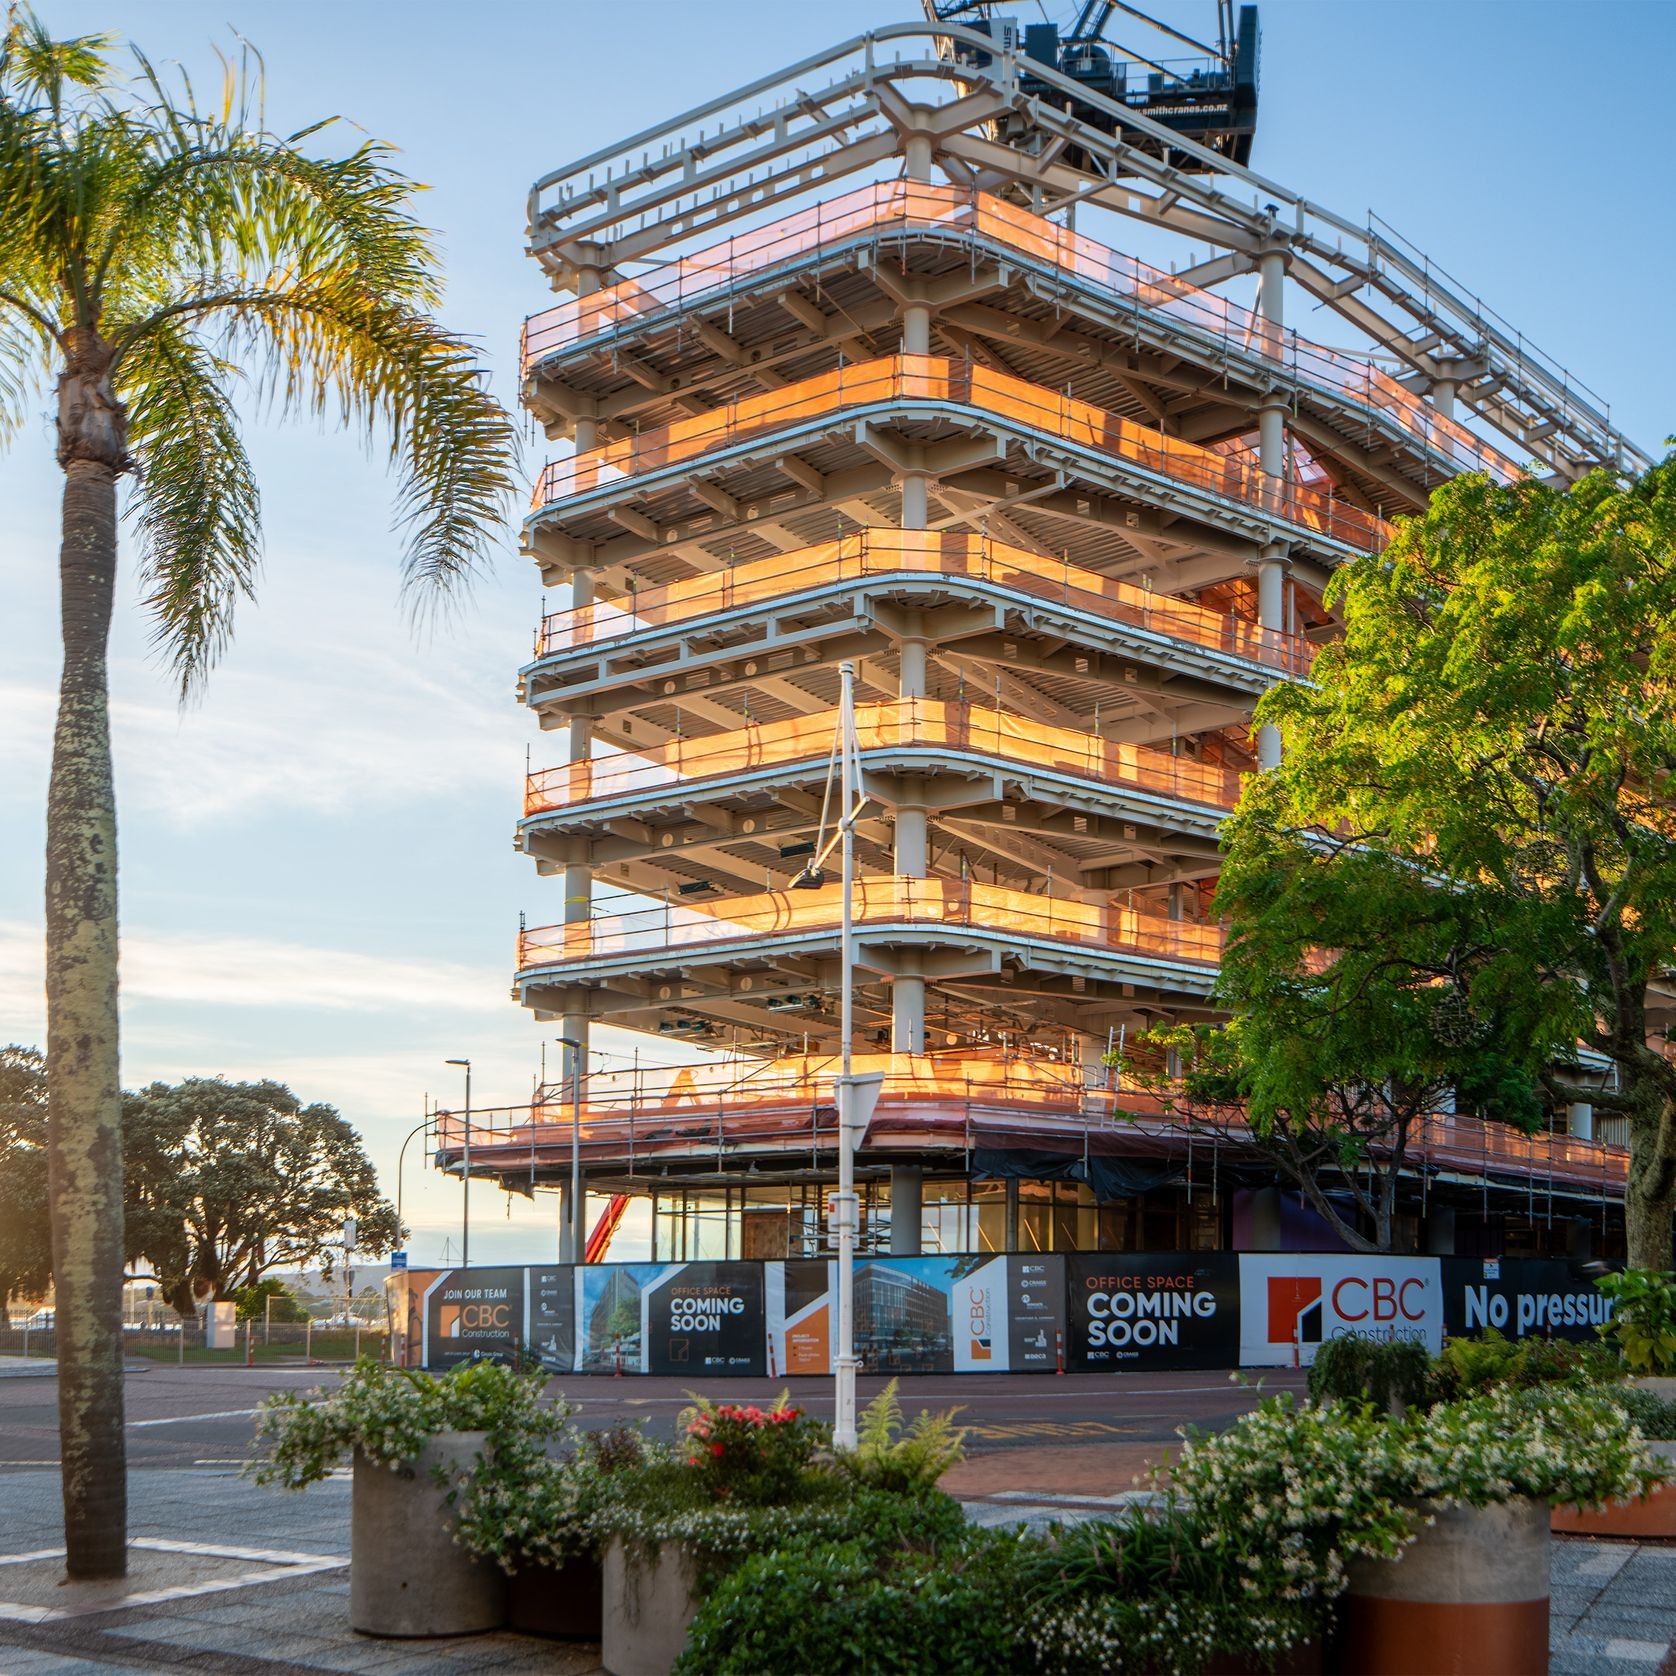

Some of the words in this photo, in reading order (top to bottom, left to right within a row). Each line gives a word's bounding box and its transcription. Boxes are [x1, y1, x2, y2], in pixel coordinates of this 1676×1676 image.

[671, 1287, 701, 1296] OFFICE
[703, 1286, 732, 1295] SPACE
[1086, 1276, 1142, 1289] OFFICE
[1147, 1276, 1195, 1289] SPACE
[443, 1289, 463, 1300] JOIN
[464, 1289, 482, 1299] OUR
[484, 1288, 507, 1299] TEAM
[1331, 1277, 1426, 1322] CBC
[670, 1297, 745, 1315] COMING
[969, 1288, 985, 1336] CBC
[1087, 1291, 1217, 1319] COMING
[1464, 1285, 1509, 1329] No
[1517, 1293, 1622, 1336] pressur
[462, 1304, 510, 1328] CBC
[670, 1314, 721, 1332] SOON
[462, 1328, 510, 1338] Construction
[1087, 1319, 1179, 1346] SOON
